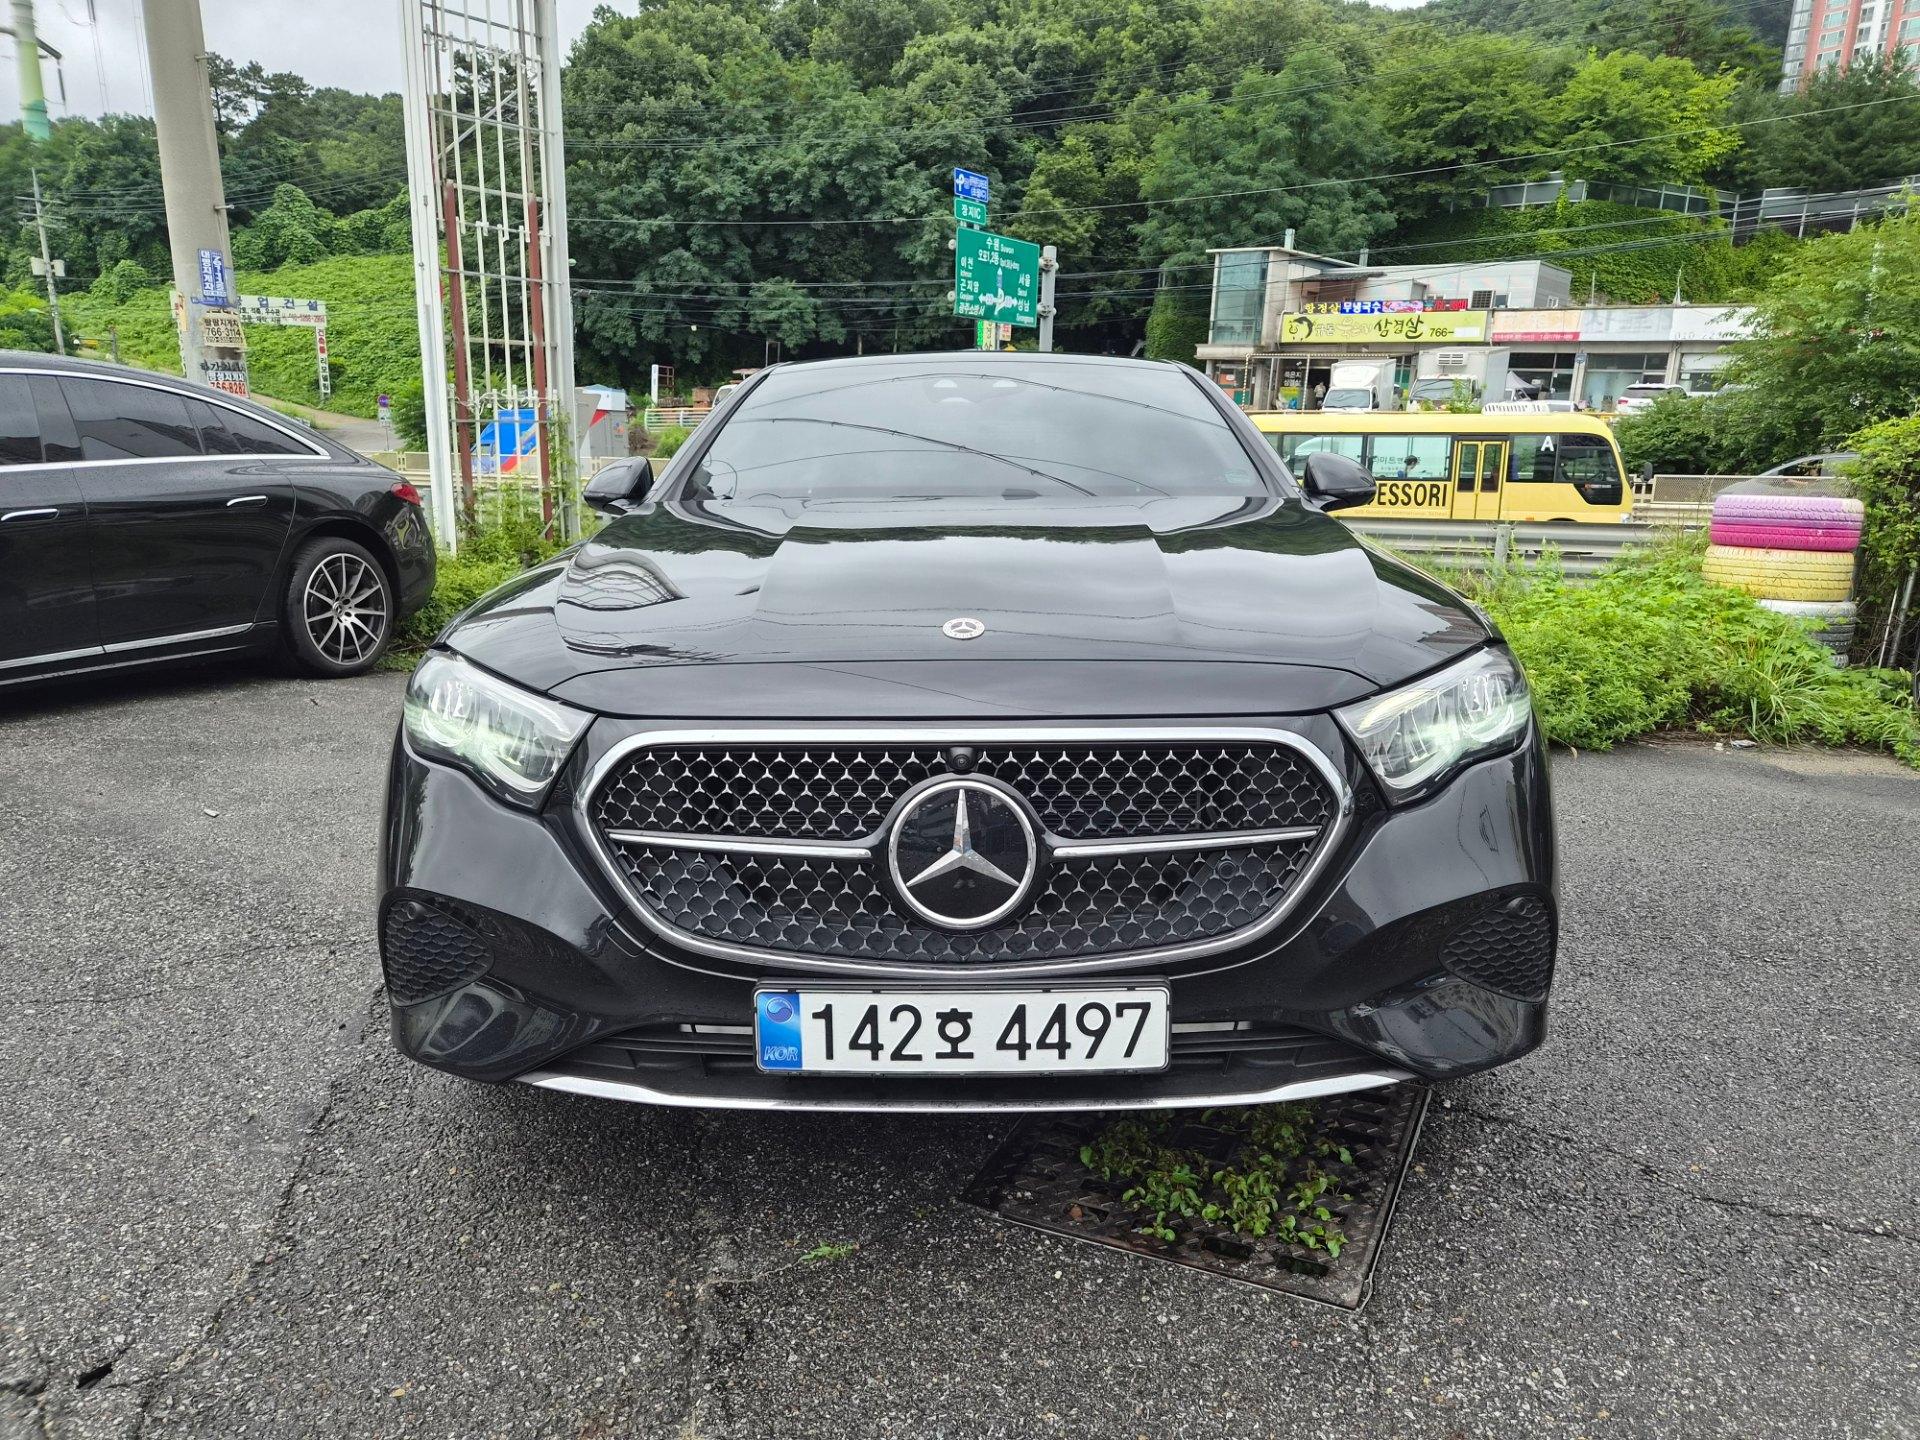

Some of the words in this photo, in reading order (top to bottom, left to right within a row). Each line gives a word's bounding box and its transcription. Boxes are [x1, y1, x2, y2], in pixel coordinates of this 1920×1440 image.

[986, 236, 999, 251] 수원
[205, 327, 241, 338] 766-3114
[1541, 435, 1555, 452] A
[1367, 482, 1448, 507] ESSORI
[811, 1003, 974, 1061] 142호
[996, 1001, 1152, 1061] 4497
[763, 1046, 798, 1063] KOR
